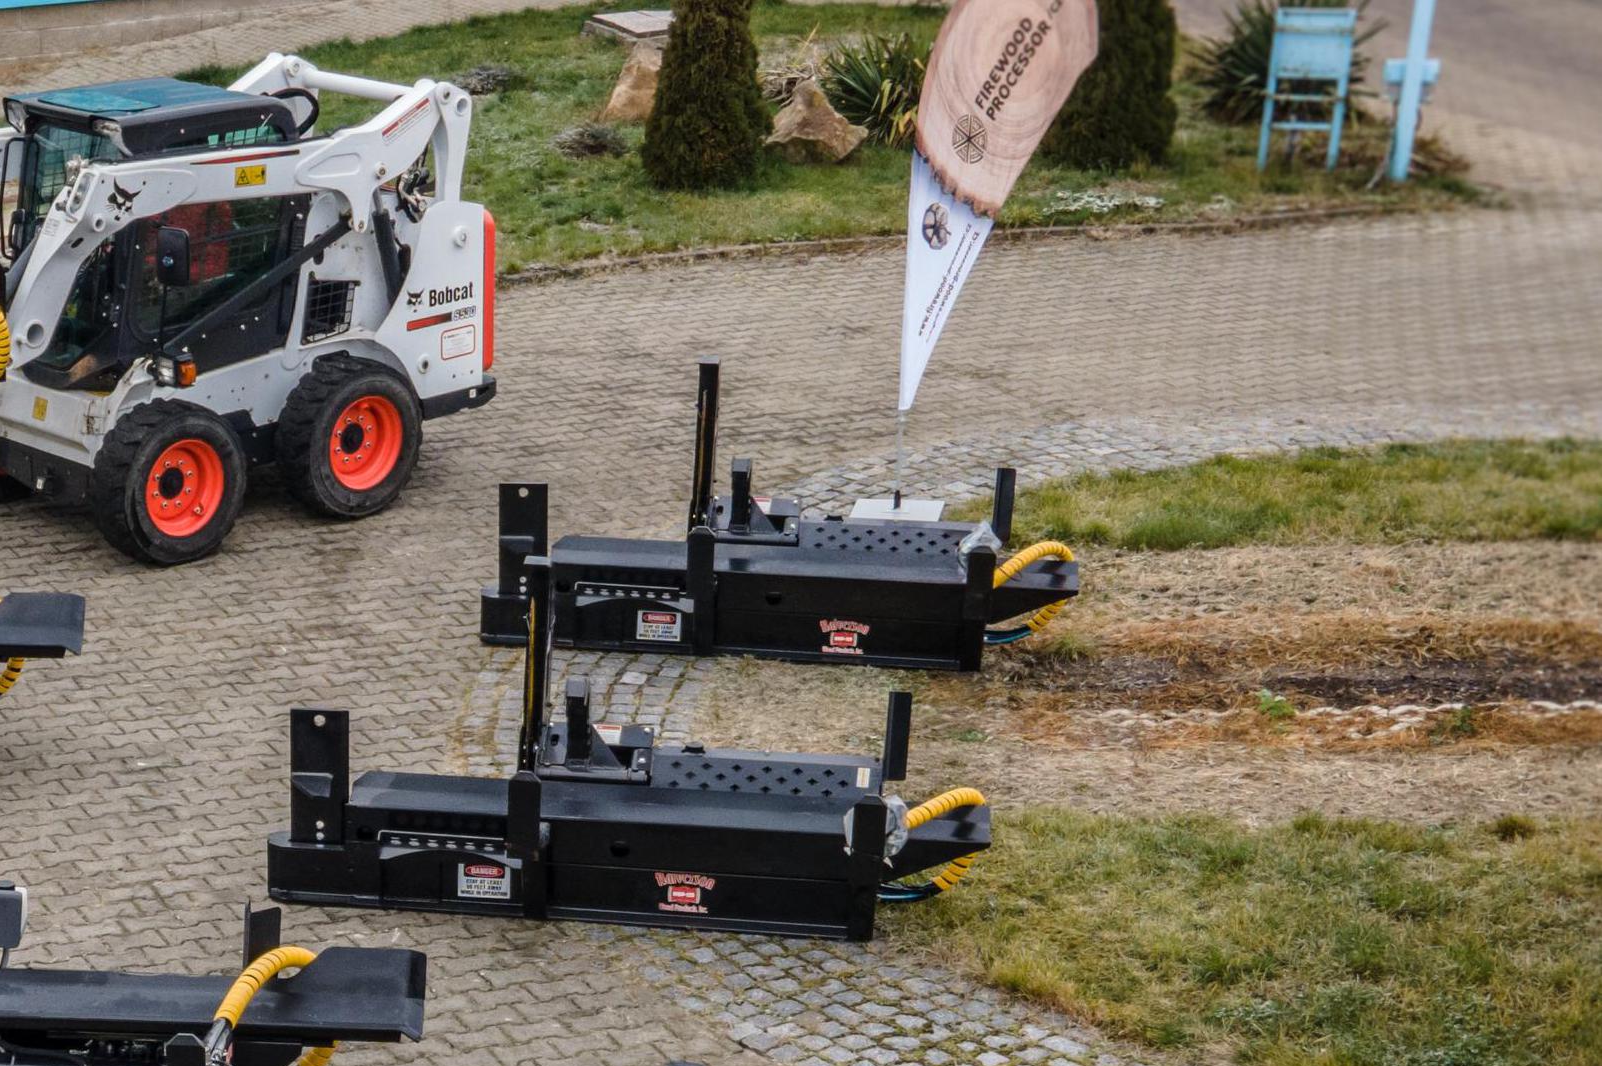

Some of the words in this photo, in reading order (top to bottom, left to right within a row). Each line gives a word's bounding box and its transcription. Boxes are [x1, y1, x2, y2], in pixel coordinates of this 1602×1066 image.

[974, 17, 1033, 110] FIREWOOD
[985, 20, 1052, 121] PROCESSOR
[428, 281, 473, 307] Bobcat
